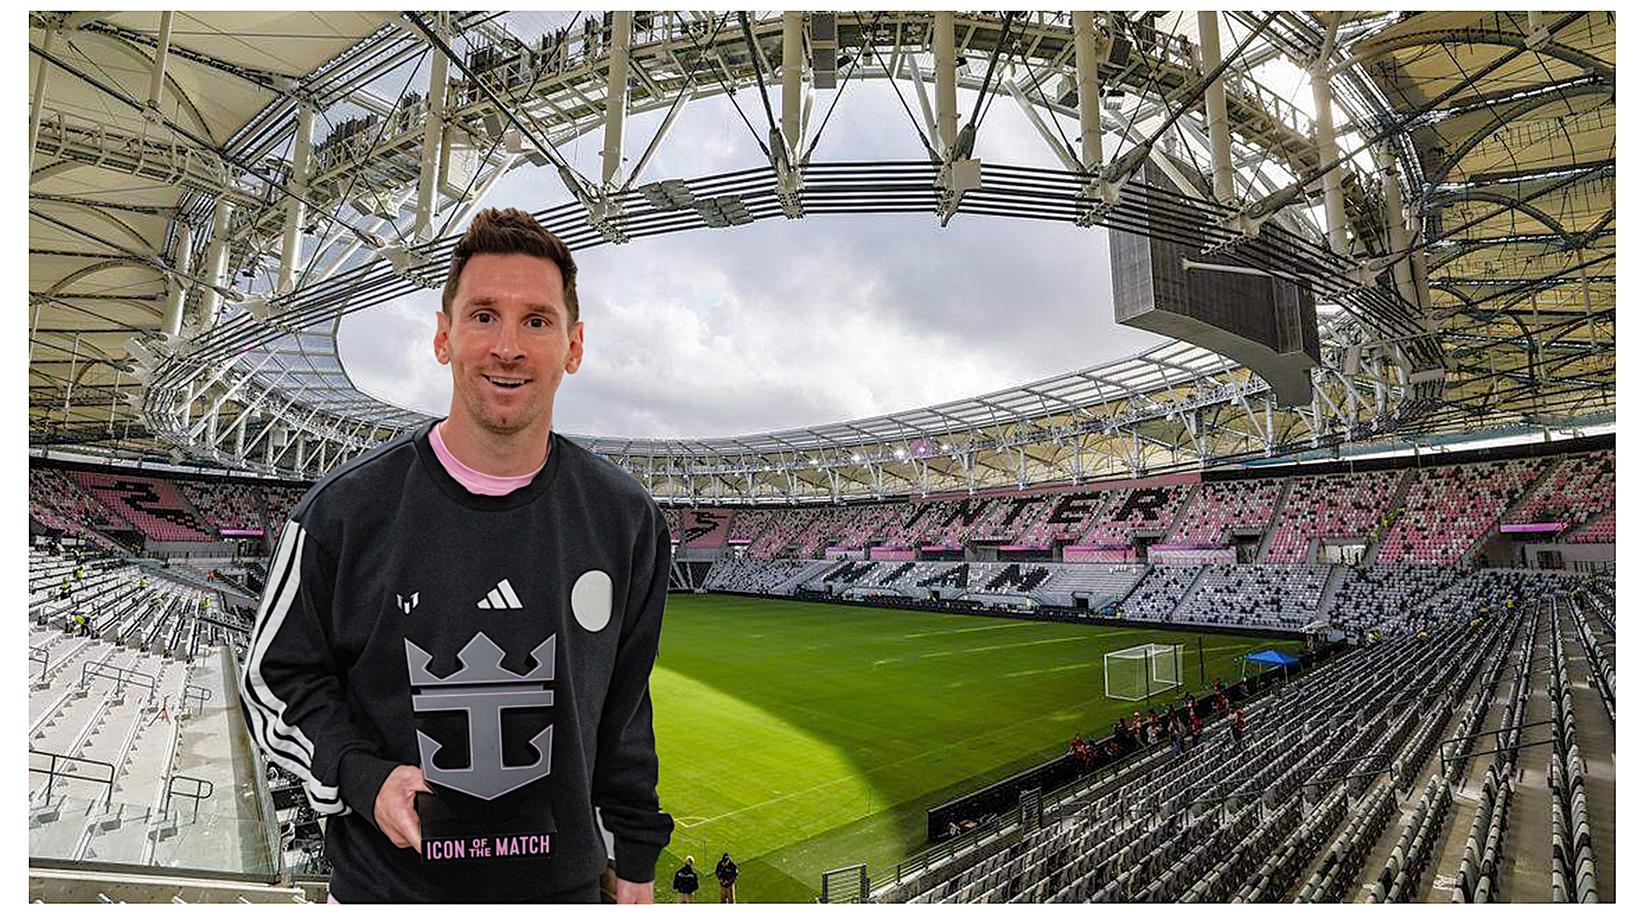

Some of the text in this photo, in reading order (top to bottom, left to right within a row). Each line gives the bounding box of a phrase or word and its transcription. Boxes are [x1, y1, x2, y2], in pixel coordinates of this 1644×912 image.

[903, 488, 1166, 529] INTER
[426, 834, 550, 860] ICON OF THE MATCH
